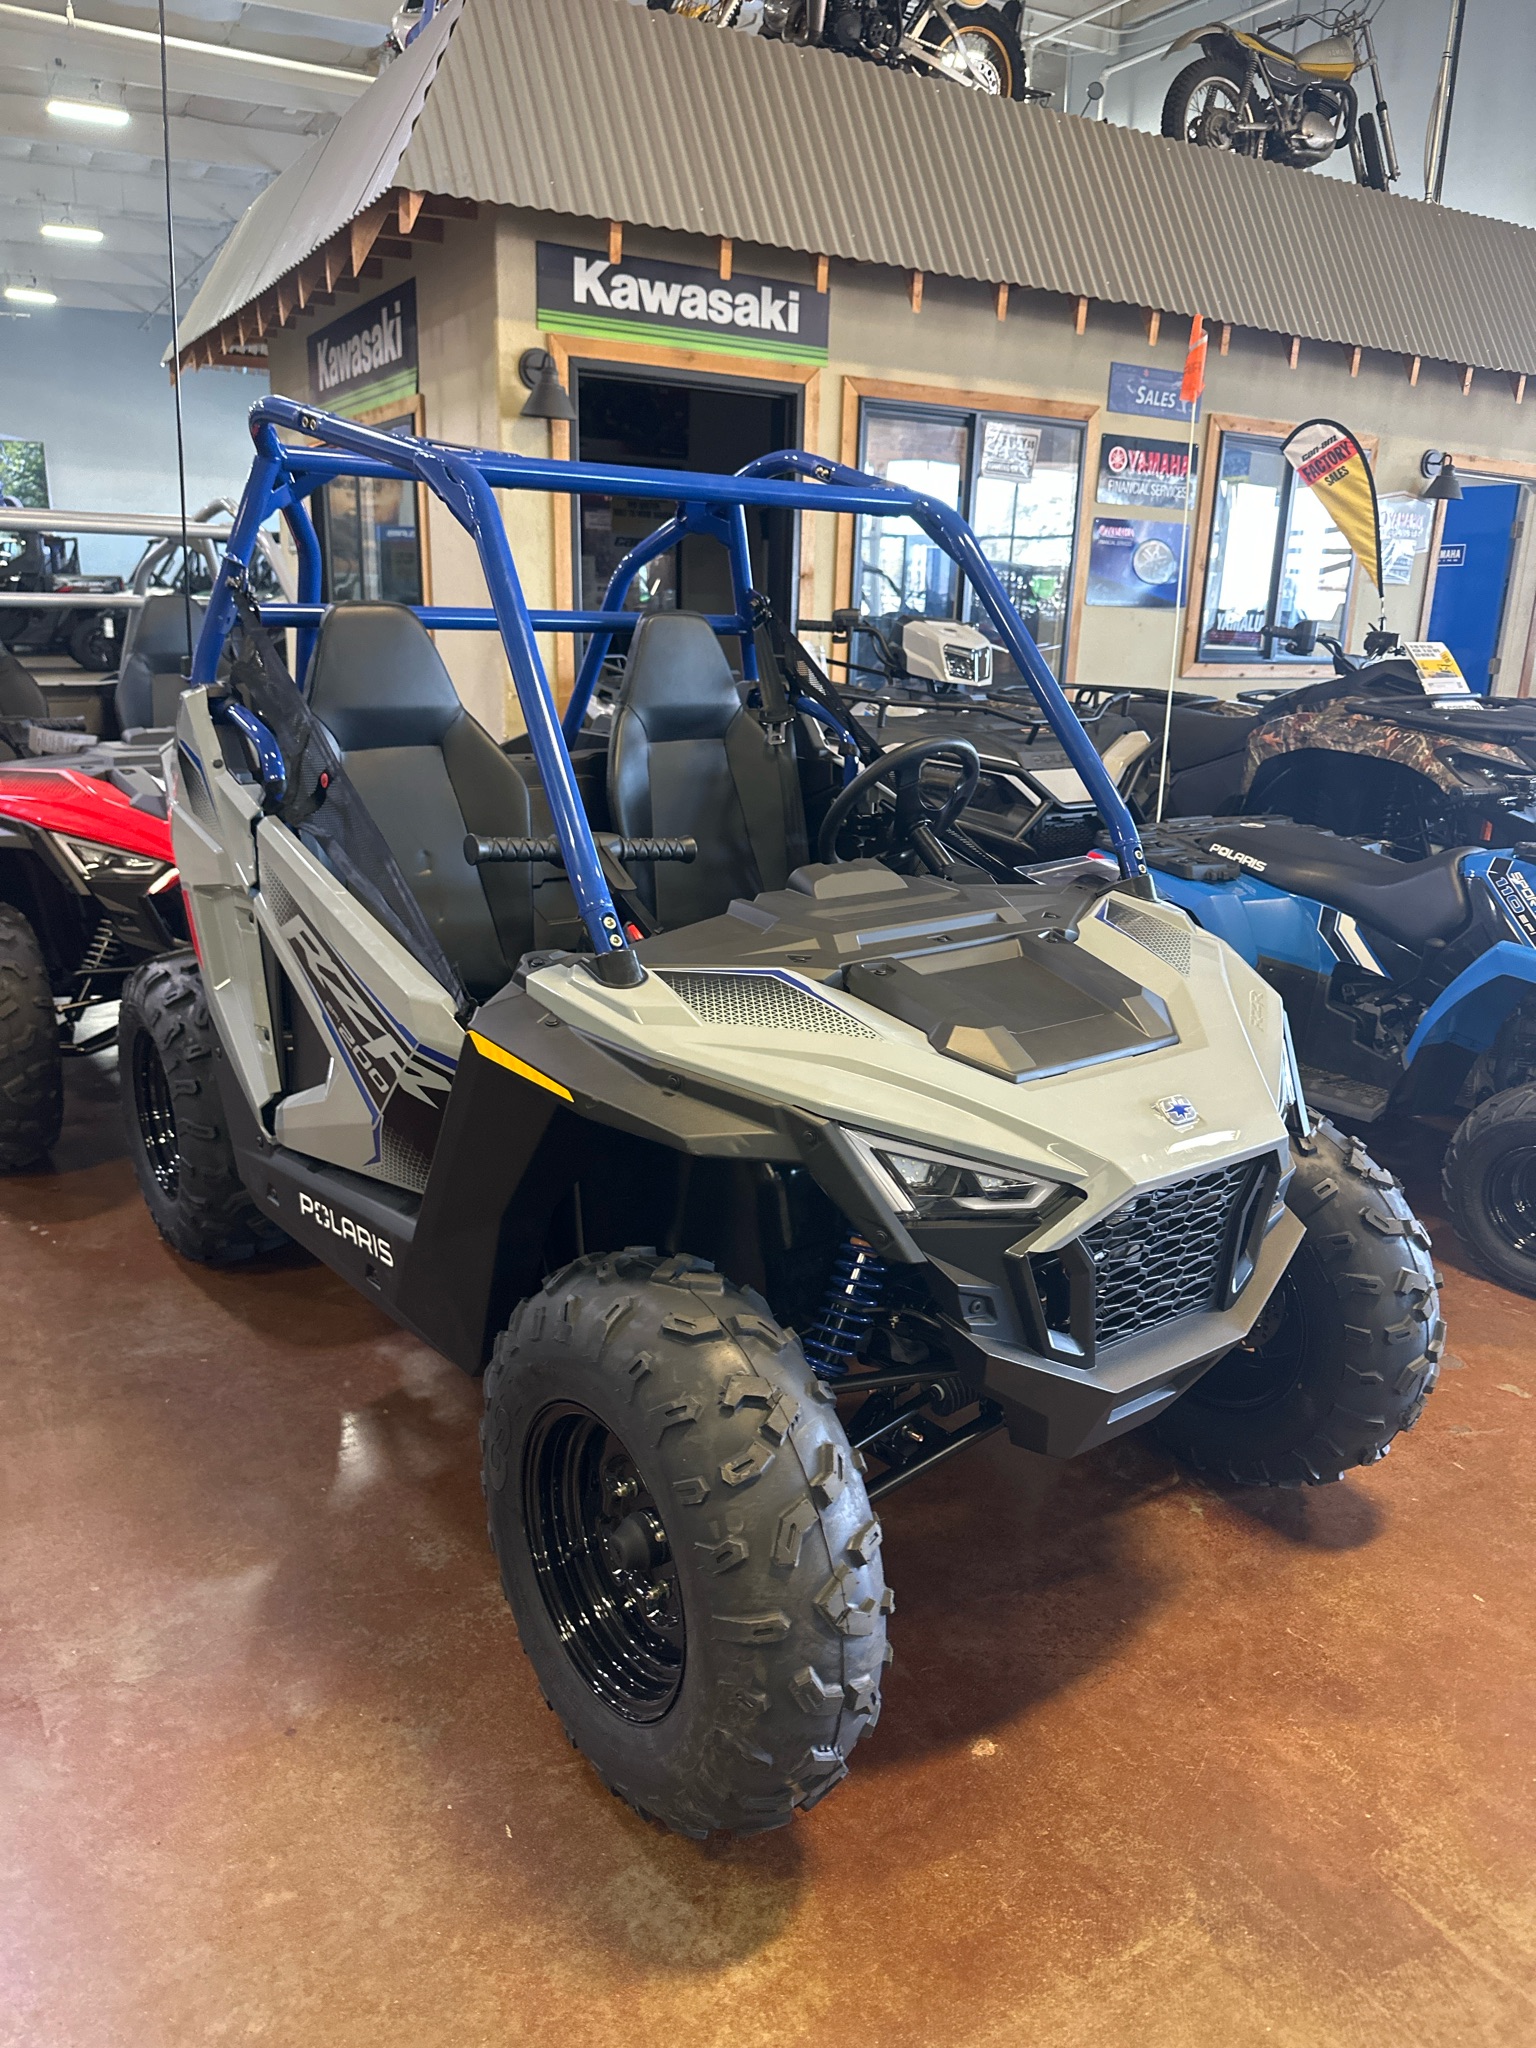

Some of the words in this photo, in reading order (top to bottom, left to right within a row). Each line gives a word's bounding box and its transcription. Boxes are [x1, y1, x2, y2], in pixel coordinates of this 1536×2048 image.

[573, 256, 799, 334] Kawasaki
[317, 300, 402, 392] Kawasaki
[1135, 385, 1177, 408] SALES
[1128, 449, 1189, 478] YAMAHA
[1302, 441, 1351, 482] FACTORY
[1324, 465, 1350, 486] SALES
[1107, 479, 1150, 496] FINANCIAL
[1439, 549, 1461, 559] MAHA
[1209, 843, 1268, 872] POLARIS
[1496, 877, 1525, 913] 110
[280, 914, 452, 1110] RZR
[339, 1022, 390, 1094] 200
[299, 1191, 394, 1268] POLARIS
